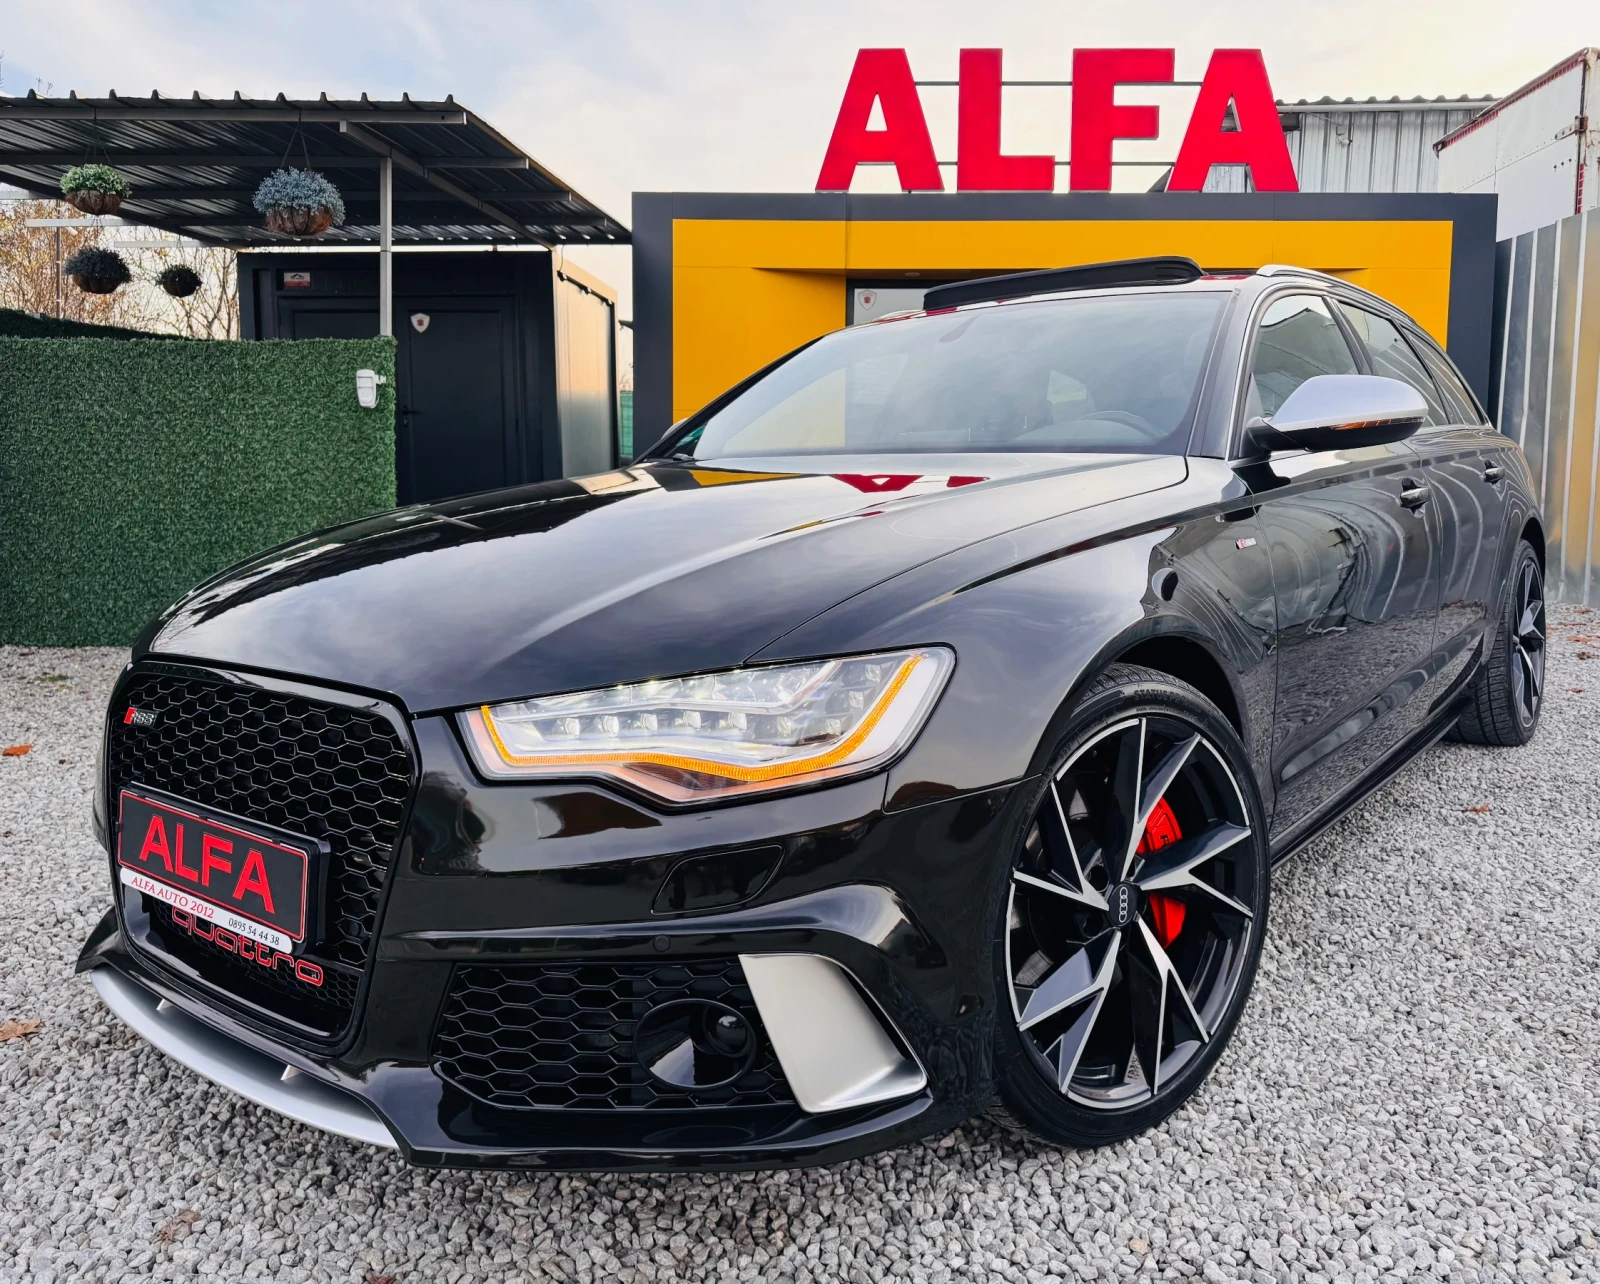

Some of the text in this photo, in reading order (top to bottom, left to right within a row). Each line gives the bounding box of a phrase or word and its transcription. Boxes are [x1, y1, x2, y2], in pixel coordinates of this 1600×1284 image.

[815, 48, 1300, 193] ALFA
[139, 815, 275, 914] ALFA
[131, 876, 280, 946] ALFA AUTO 2012 0895 54 44 38
[172, 905, 324, 987] quattro
